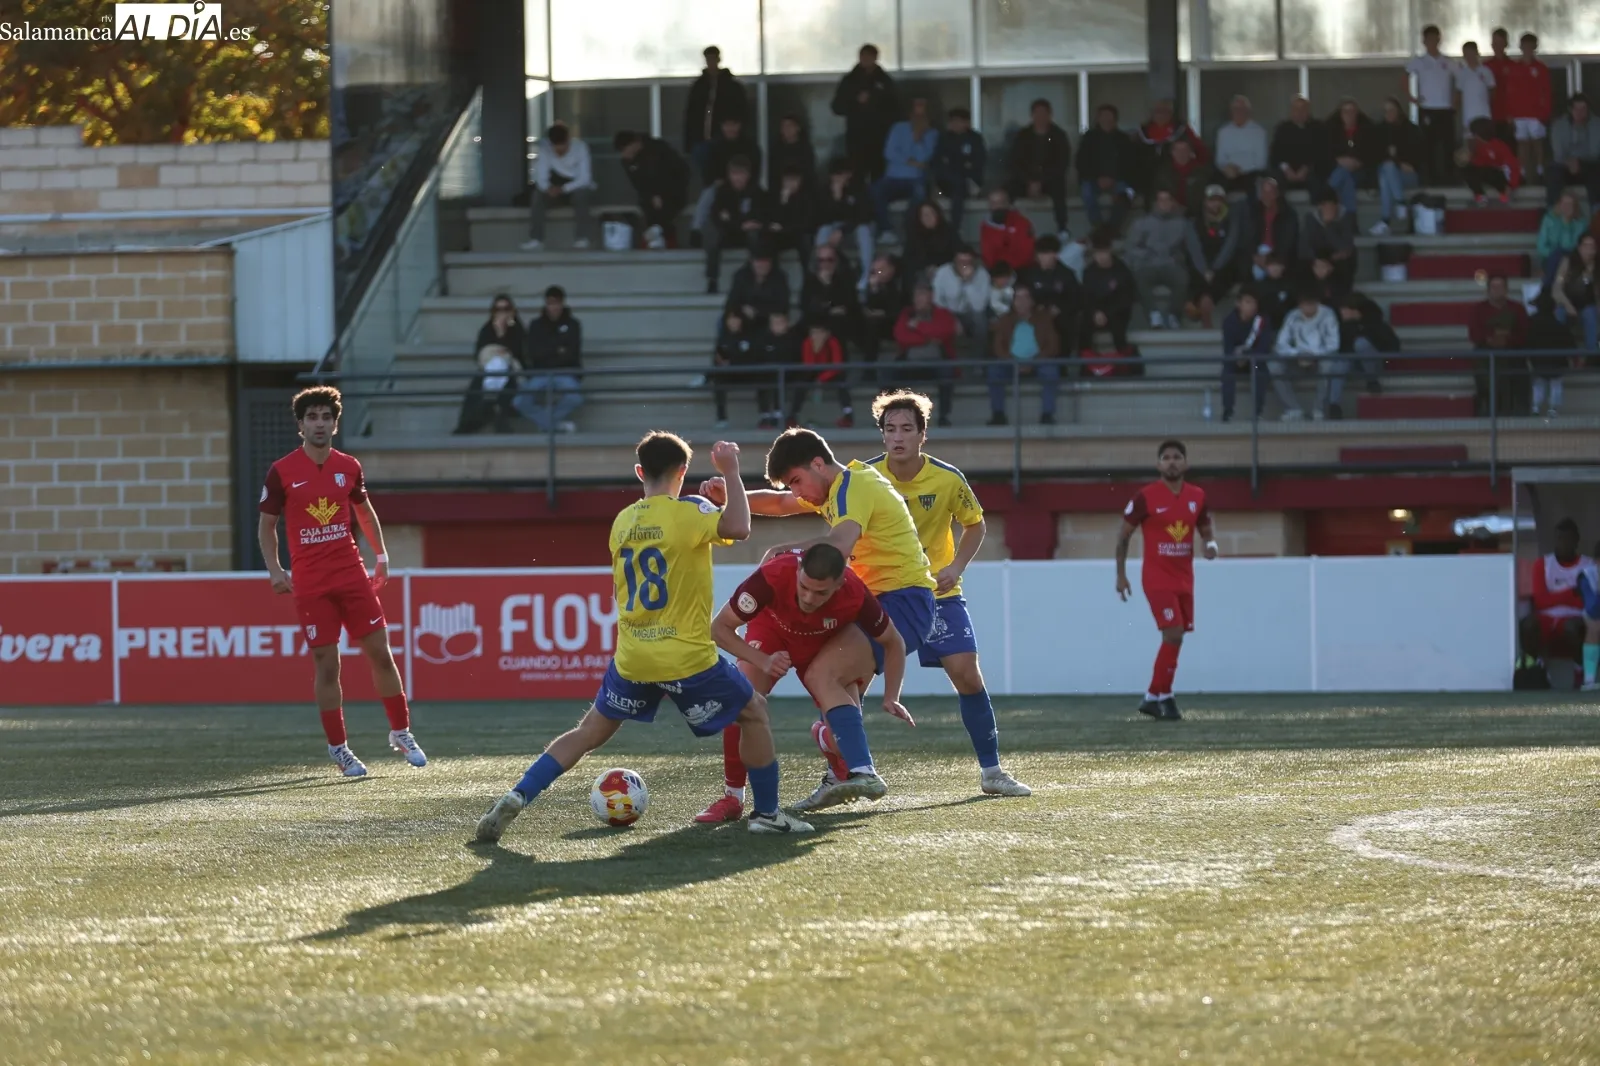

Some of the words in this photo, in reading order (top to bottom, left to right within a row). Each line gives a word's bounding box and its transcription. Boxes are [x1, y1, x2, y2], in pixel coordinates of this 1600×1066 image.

[300, 527, 321, 537] CAJA
[322, 522, 347, 534] RURAL
[619, 547, 668, 612] 18
[632, 627, 657, 639] MIGUEL
[0, 626, 102, 662] vera
[498, 655, 562, 671] CUANDO
[563, 655, 582, 670] LA
[606, 688, 647, 709] TELENO
